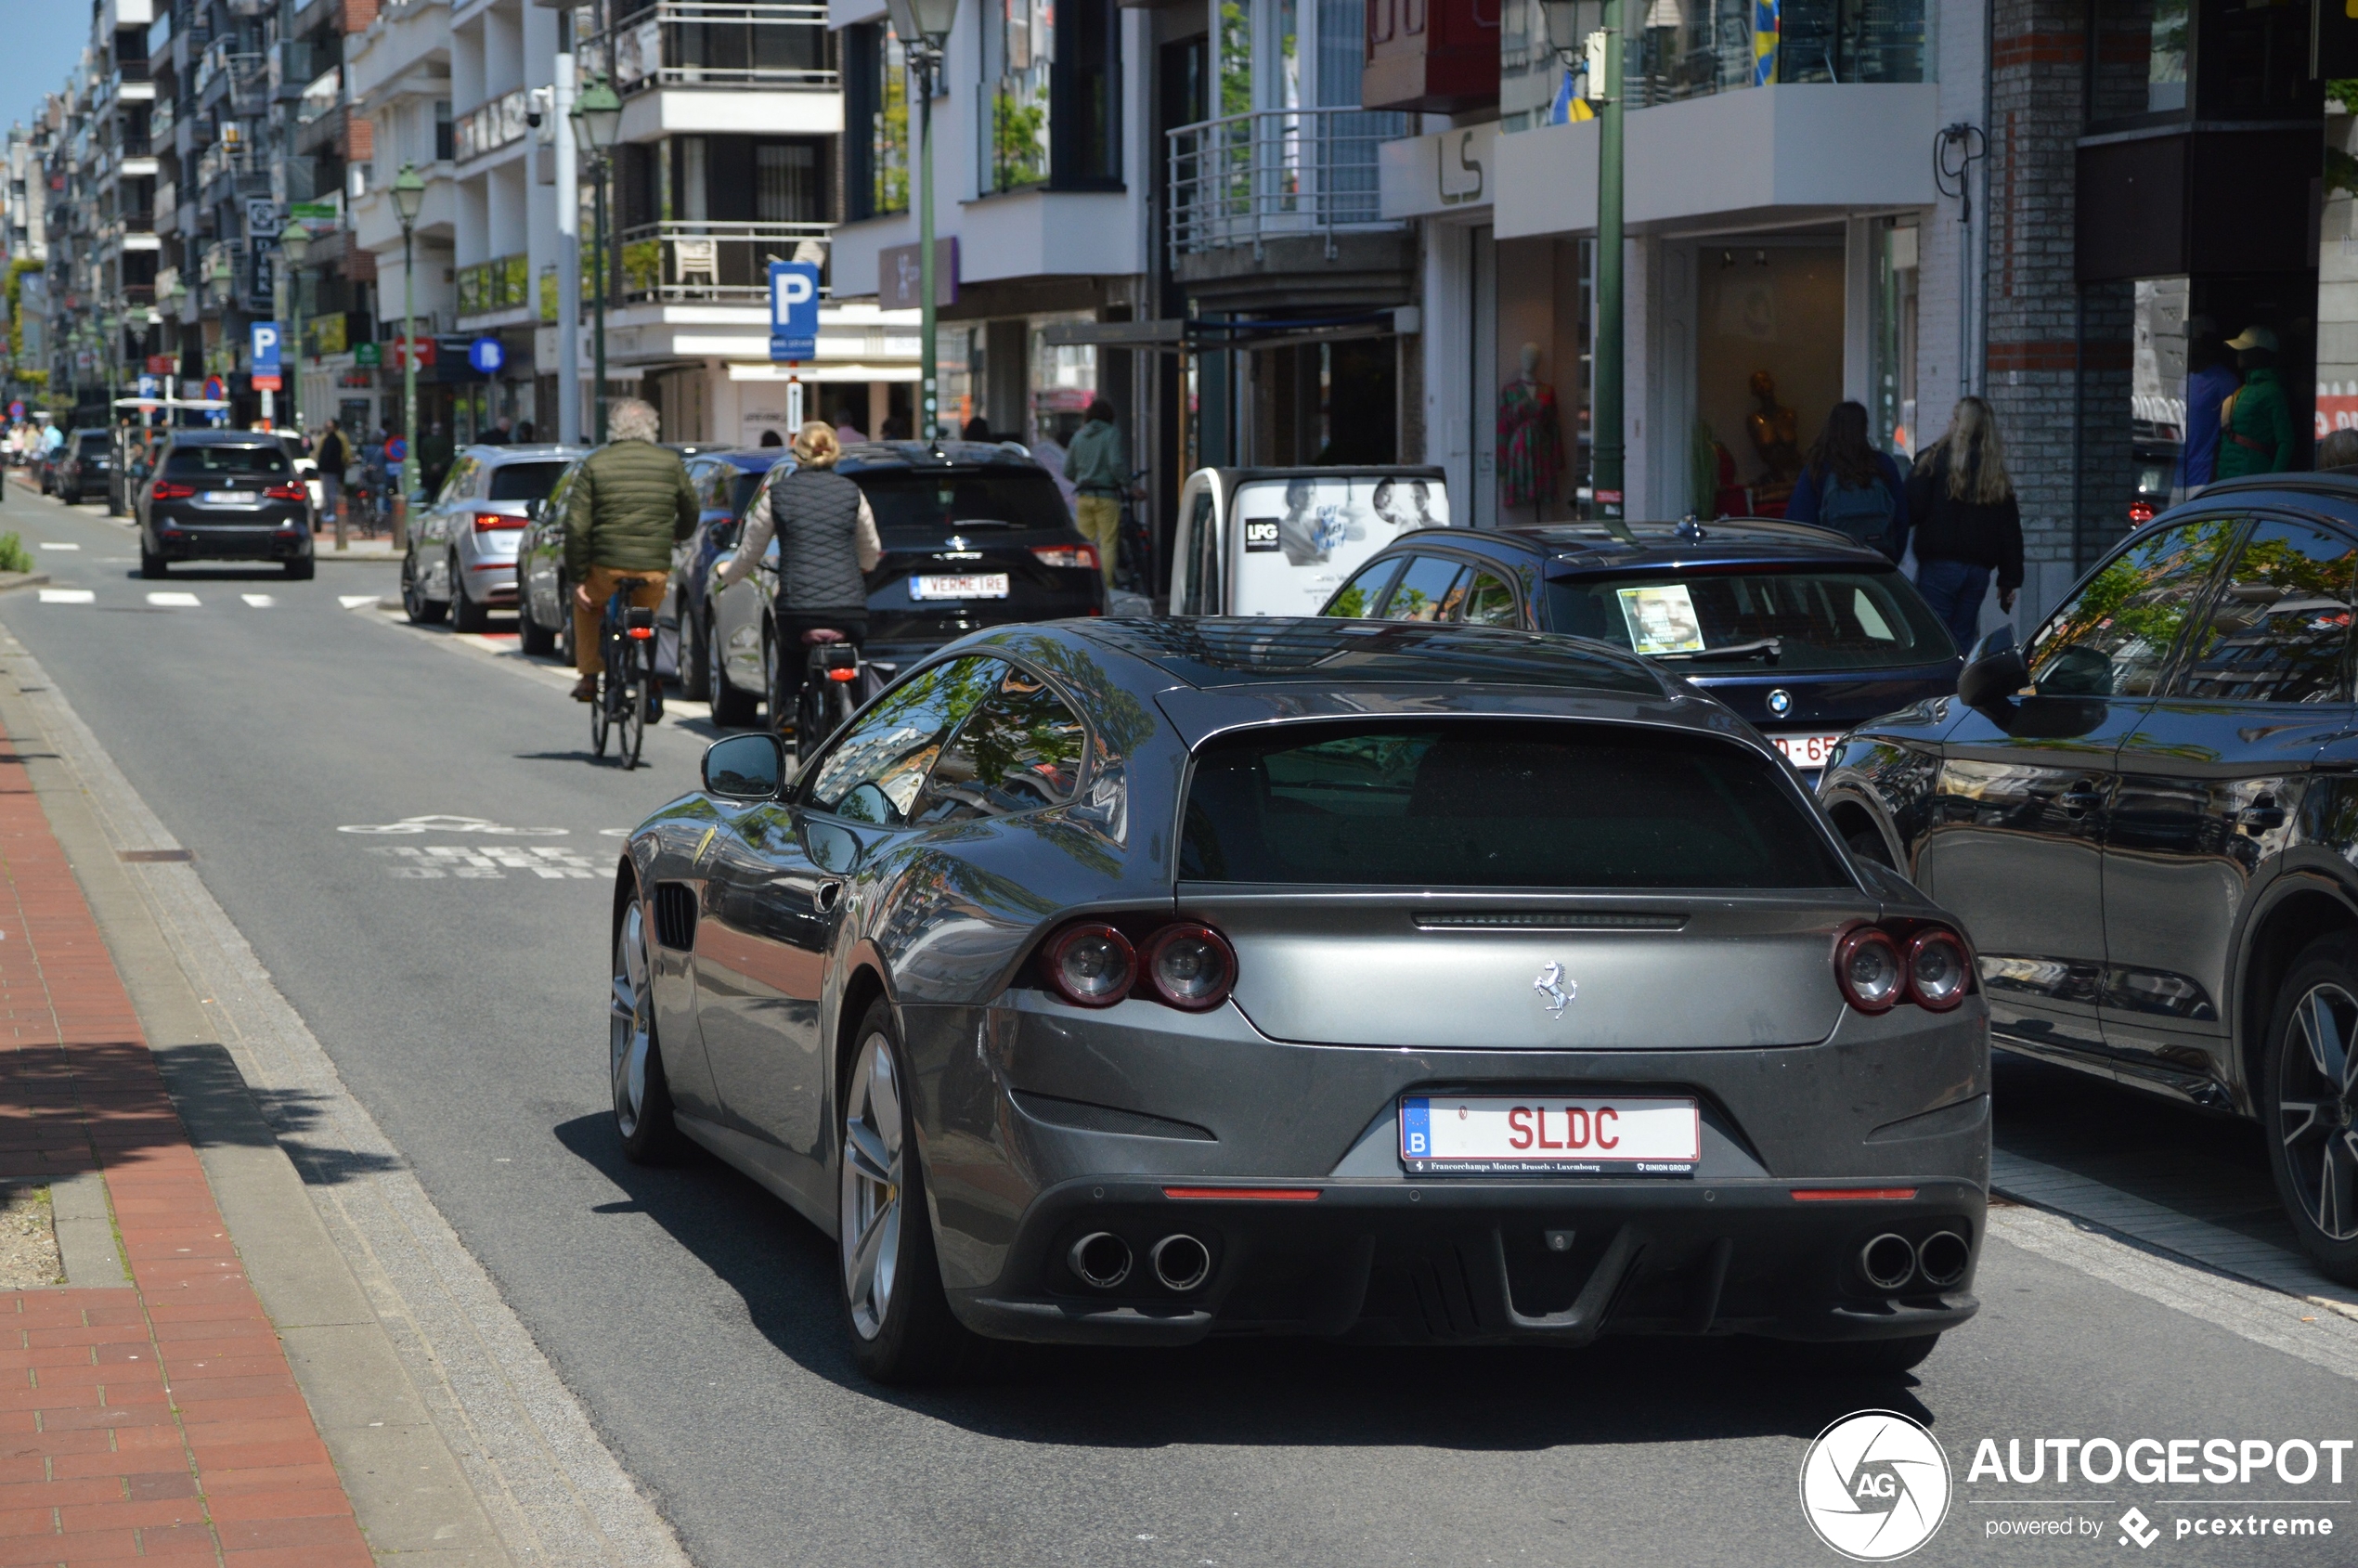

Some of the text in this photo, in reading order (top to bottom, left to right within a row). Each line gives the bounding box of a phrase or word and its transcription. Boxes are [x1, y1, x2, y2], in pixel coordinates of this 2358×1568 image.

[1438, 131, 1483, 205] LS
[775, 273, 813, 325] P
[253, 328, 278, 358] P
[139, 376, 153, 395] P
[1247, 524, 1278, 540] LPG
[1509, 1106, 1619, 1149] SLDC
[1410, 1133, 1426, 1152] B
[1431, 1162, 1490, 1172] Francorchamps
[1492, 1162, 1520, 1171] Motors
[1522, 1162, 1550, 1171] Brussels
[1557, 1162, 1600, 1172] Luxembourg
[1645, 1163, 1691, 1172] GINION GROUP
